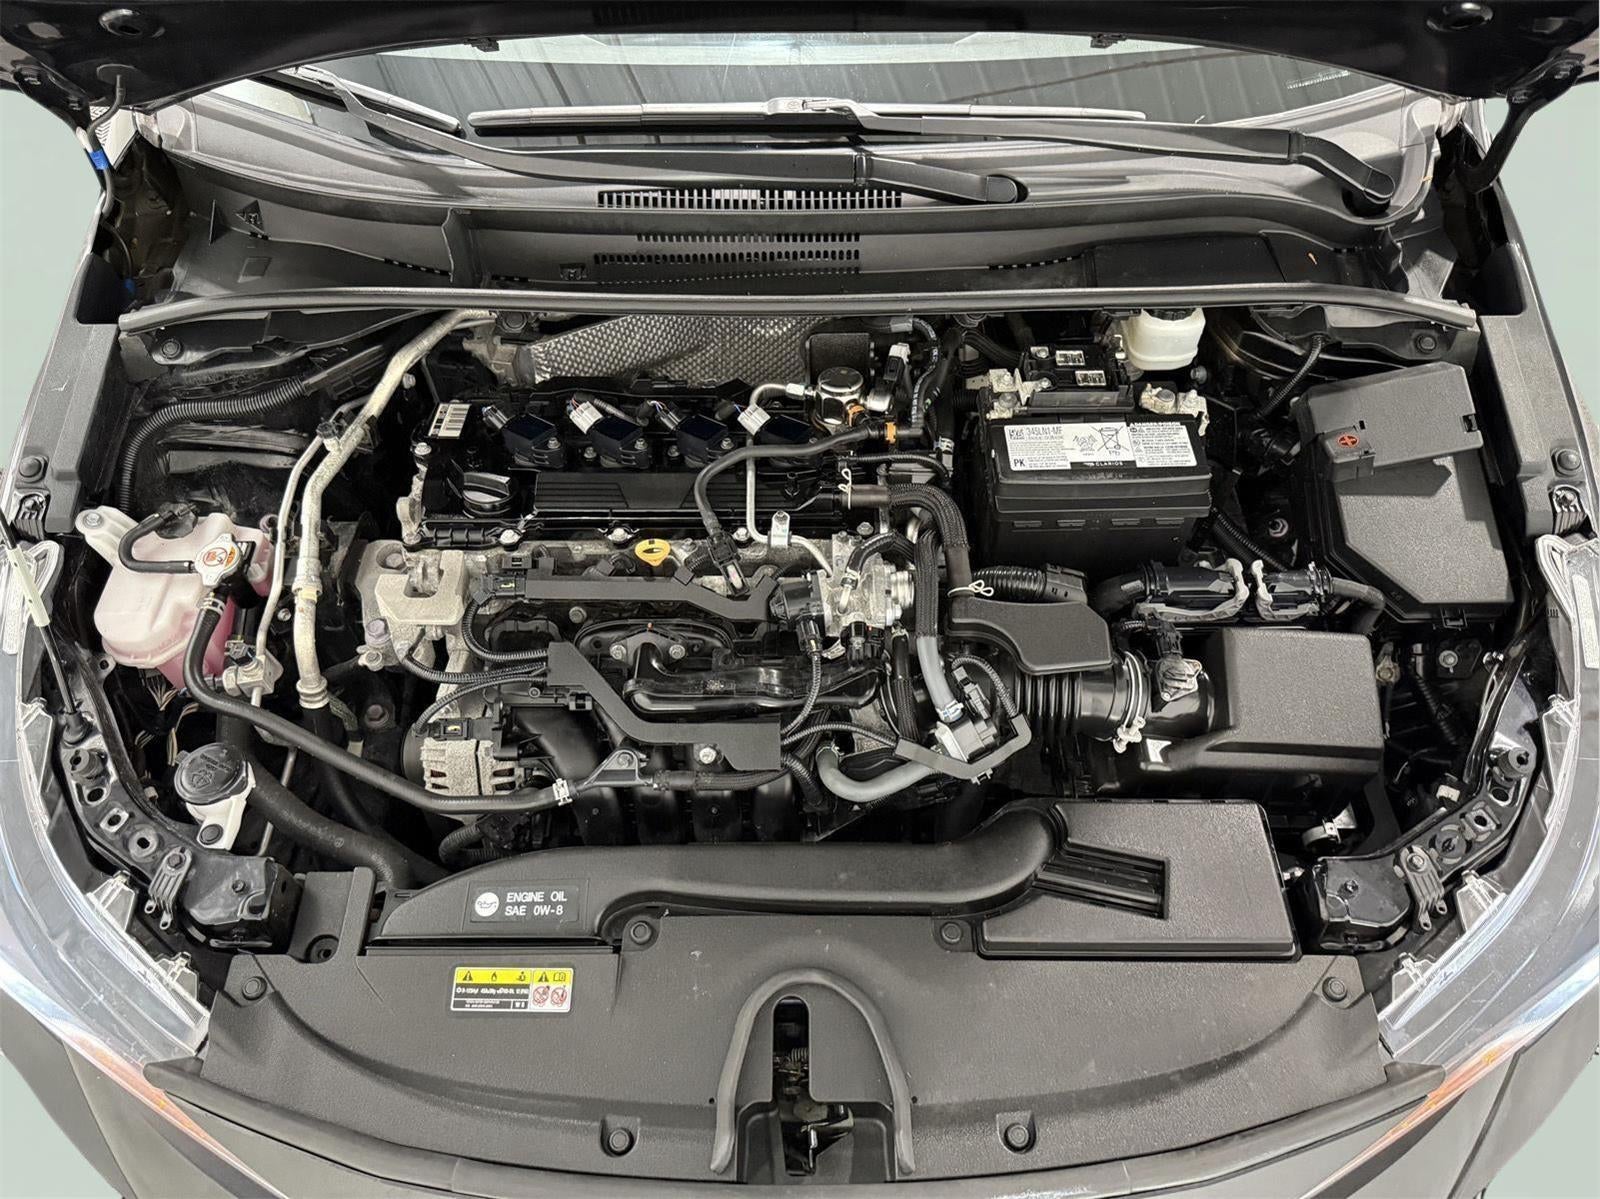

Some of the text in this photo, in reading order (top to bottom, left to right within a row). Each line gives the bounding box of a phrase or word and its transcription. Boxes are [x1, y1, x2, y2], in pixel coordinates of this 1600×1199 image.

[1013, 458, 1026, 467] PK
[506, 891, 568, 903] ENGINE OIL
[504, 905, 564, 916] SAE 0W-8
